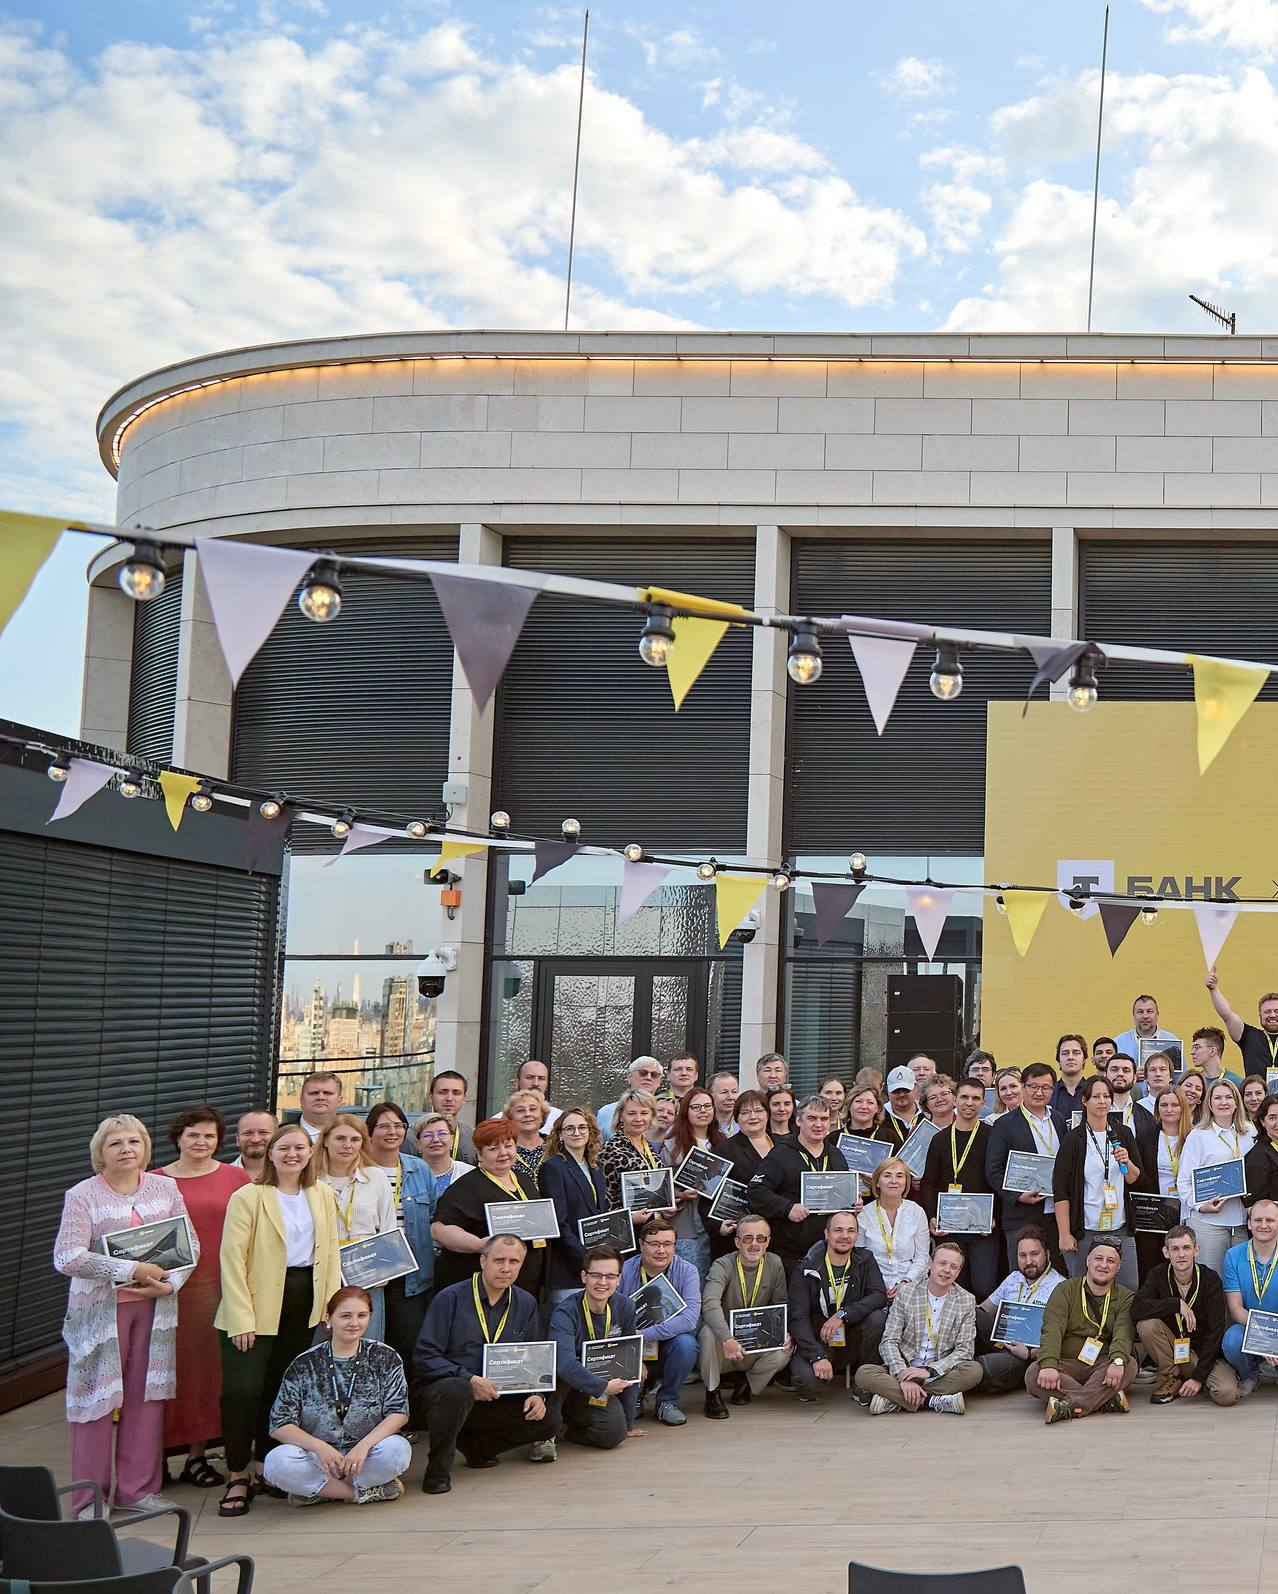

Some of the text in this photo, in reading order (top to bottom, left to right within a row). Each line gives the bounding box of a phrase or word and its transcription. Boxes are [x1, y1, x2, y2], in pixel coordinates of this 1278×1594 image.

[1127, 876, 1241, 900] БАНК
[841, 1144, 867, 1153] Сертификат
[1196, 1175, 1222, 1183] Сертификат
[1001, 1313, 1027, 1321] Сертификат
[1251, 1323, 1278, 1333] Сертификат
